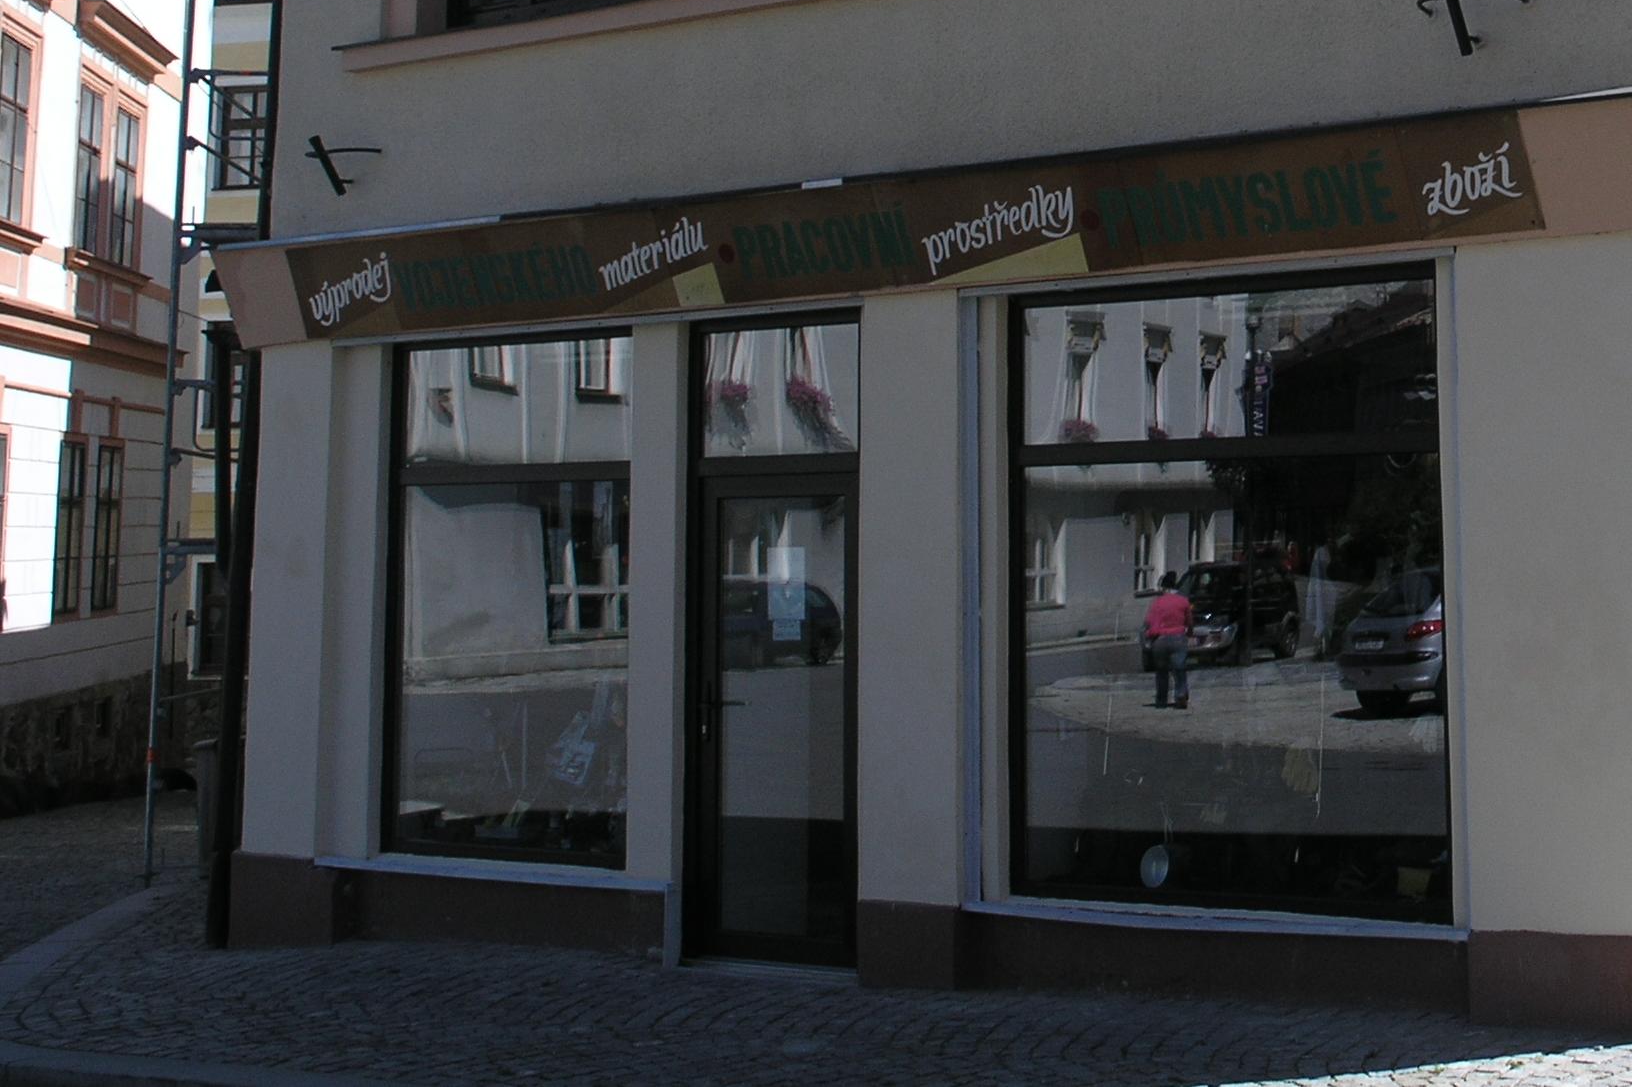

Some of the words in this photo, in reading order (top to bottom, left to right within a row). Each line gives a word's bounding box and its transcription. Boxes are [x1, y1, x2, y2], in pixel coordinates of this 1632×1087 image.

[308, 251, 392, 327] výprodej
[599, 216, 708, 291] materiálu
[733, 201, 916, 281] PRACOVNÍ
[921, 184, 1074, 277] prostředky
[1421, 140, 1524, 217] zboží
